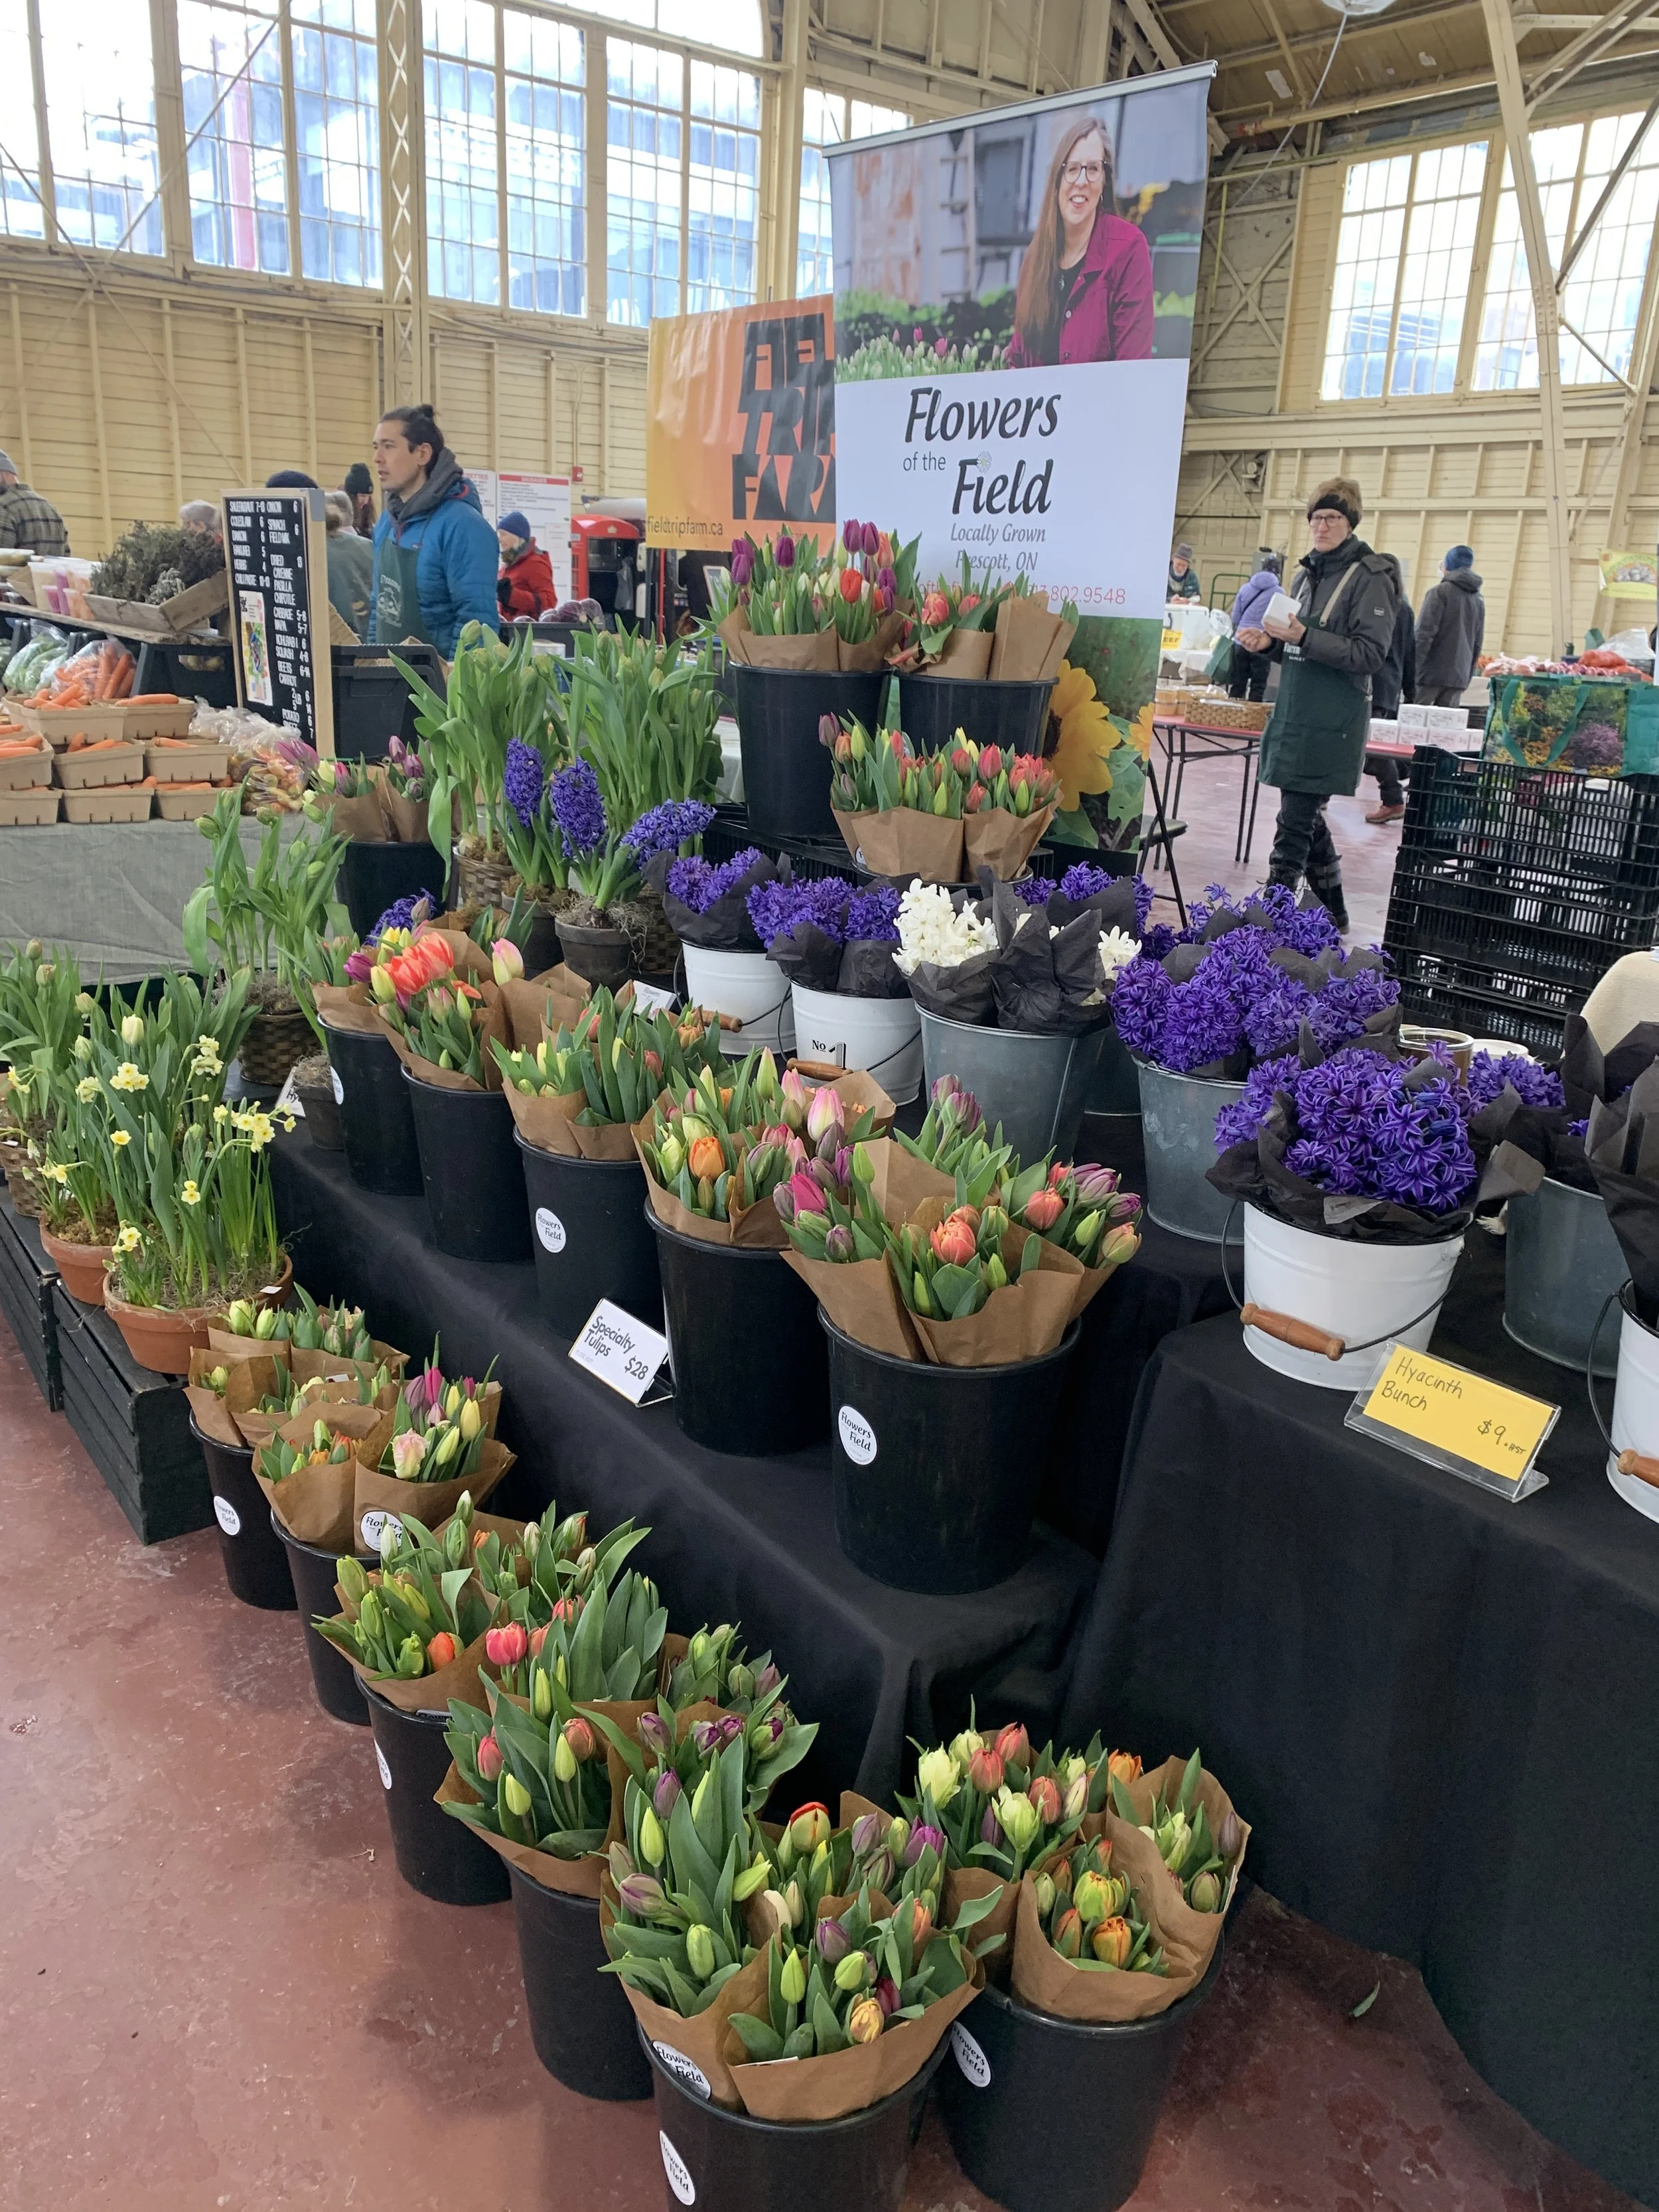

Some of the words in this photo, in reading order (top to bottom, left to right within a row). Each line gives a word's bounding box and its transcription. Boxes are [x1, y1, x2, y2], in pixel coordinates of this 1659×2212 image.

[904, 387, 1062, 443] Flowers
[903, 451, 918, 471] of
[923, 451, 946, 471] the
[952, 459, 1054, 515] Field
[293, 500, 298, 513] 6
[259, 516, 265, 528] 6
[295, 524, 299, 536] 6
[646, 515, 723, 538] fieldtripfarm.ca
[261, 530, 265, 543] 6
[950, 523, 998, 546] Locally
[1002, 522, 1046, 543] Grown
[261, 546, 266, 557] 5
[956, 550, 1011, 572] Pescott,
[1016, 551, 1039, 571] ON
[262, 561, 267, 573] 4
[273, 579, 293, 593] PASILLA
[273, 591, 296, 606] CHIPOTLE
[297, 621, 308, 635] 5-7
[275, 645, 295, 660] SQUASH
[301, 638, 307, 650] 6
[305, 690, 311, 702] 6
[281, 708, 300, 723] POTATO
[307, 715, 313, 727] 6
[309, 727, 314, 739] 7
[812, 1039, 826, 1052] No
[828, 1041, 847, 1070] 1
[538, 1213, 561, 1230] Flowers
[545, 1227, 562, 1240] Field
[584, 1329, 612, 1357] Tulips
[592, 1315, 636, 1355] Specialty
[624, 1355, 649, 1380] $28
[1394, 1356, 1463, 1399] Hyacinth
[1380, 1380, 1428, 1412] Bunch
[841, 1411, 871, 1439] Flowers
[850, 1431, 871, 1452] Field
[222, 1512, 236, 1525] Field
[656, 2046, 697, 2071] Flowers
[962, 2048, 985, 2077] Field
[675, 2065, 705, 2084] Field
[670, 2163, 690, 2193] Field
